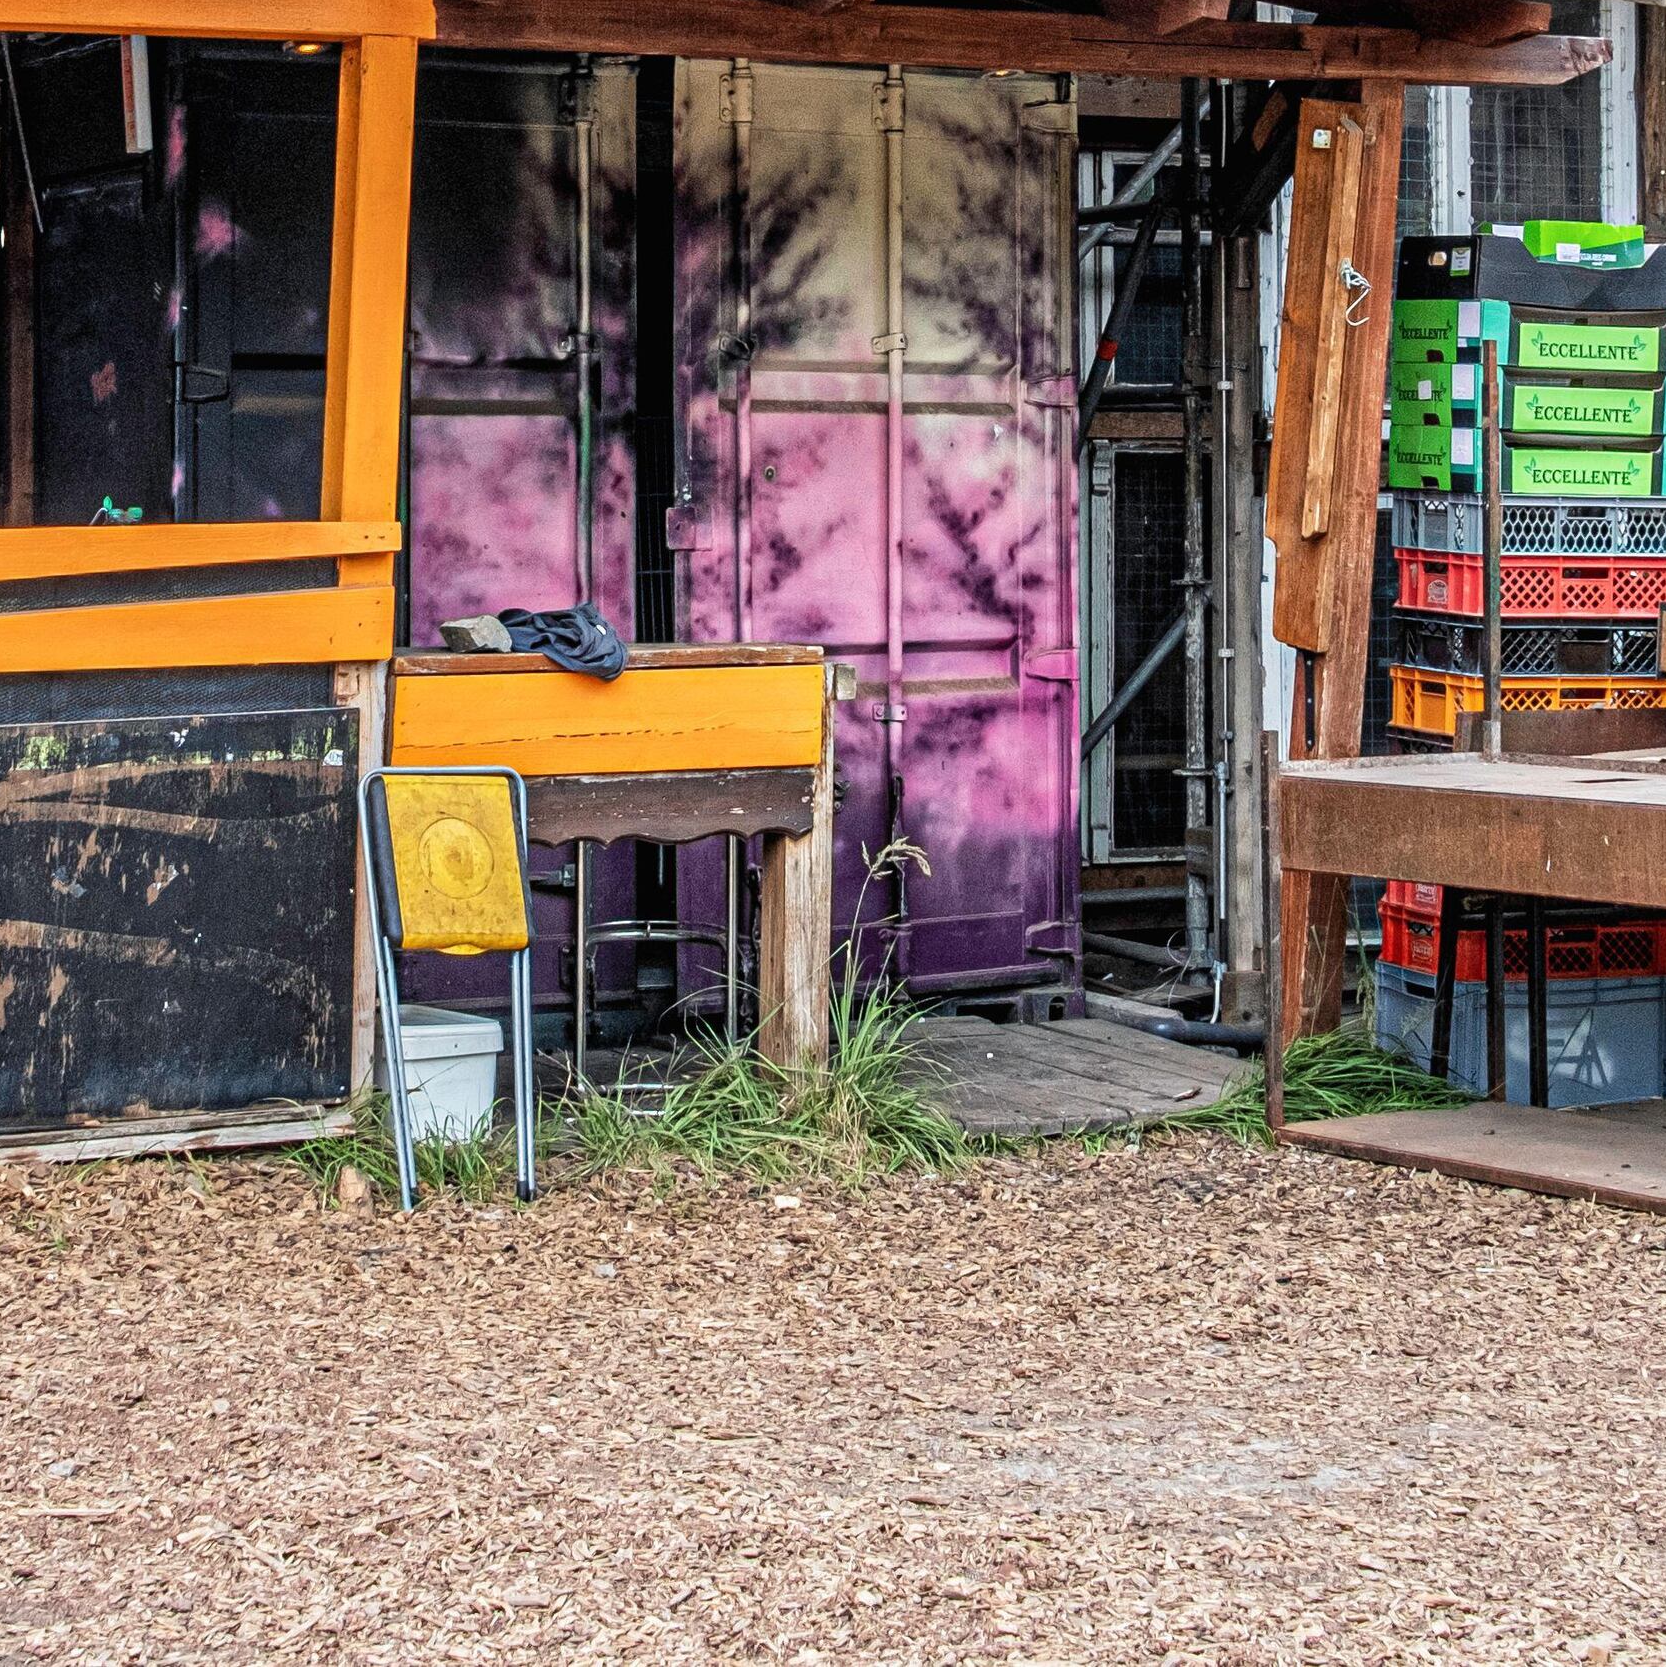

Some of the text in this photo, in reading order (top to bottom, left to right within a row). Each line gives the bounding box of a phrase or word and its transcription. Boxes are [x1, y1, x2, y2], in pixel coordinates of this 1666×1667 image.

[1539, 342, 1638, 360] ECCELLENTE
[1534, 405, 1633, 423] ECCELLENTE
[1532, 469, 1632, 486] ECCELLENTE
